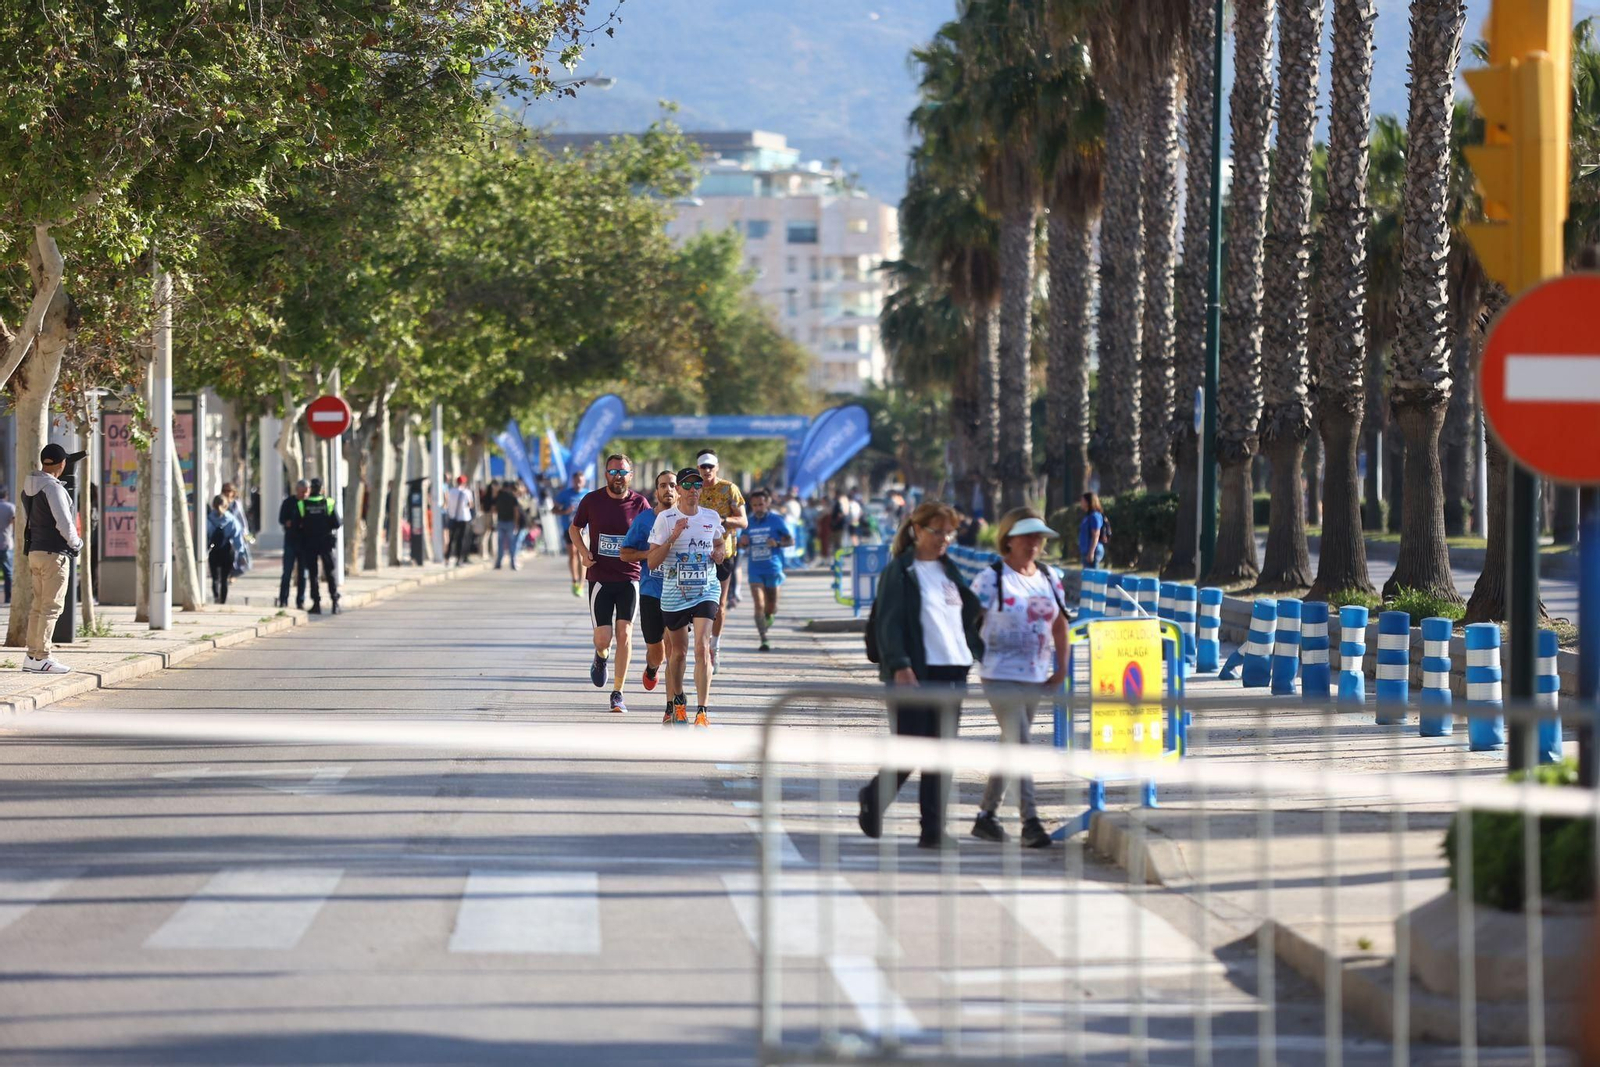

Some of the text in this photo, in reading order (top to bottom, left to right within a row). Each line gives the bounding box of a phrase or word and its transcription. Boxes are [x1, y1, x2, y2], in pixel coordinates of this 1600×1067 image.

[108, 424, 129, 440] 06
[108, 516, 138, 531] IVT
[681, 571, 705, 579] 1711
